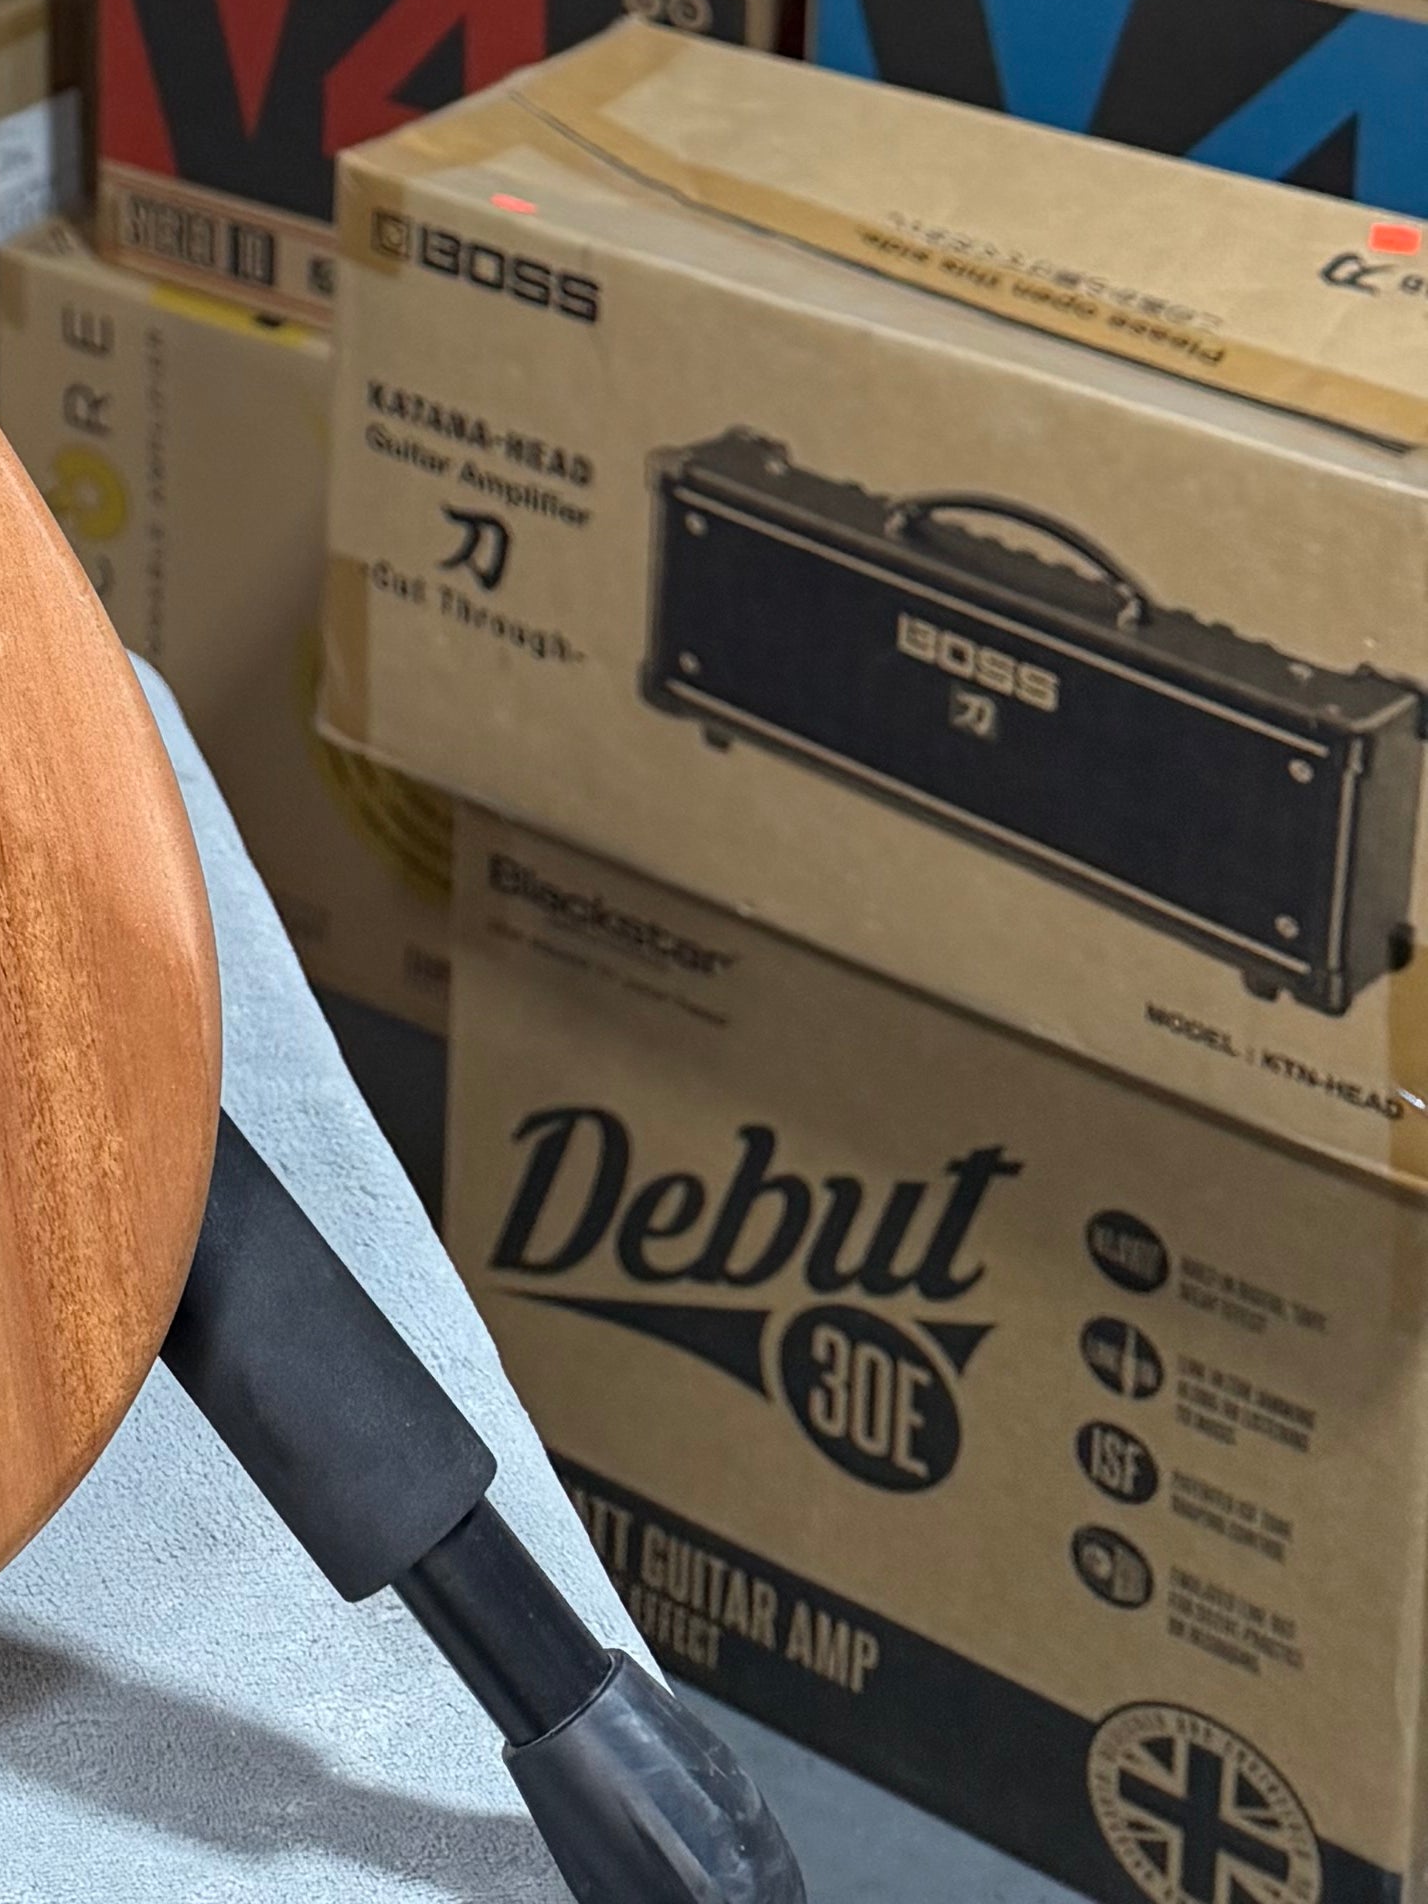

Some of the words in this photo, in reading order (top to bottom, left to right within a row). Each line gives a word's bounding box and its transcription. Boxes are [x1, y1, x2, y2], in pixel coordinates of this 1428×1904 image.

[418, 224, 600, 326] BOSS
[364, 423, 452, 477] Guitar
[457, 461, 592, 529] Amplifier
[365, 378, 596, 489] KATANA-HEAD
[896, 610, 1061, 714] BOSS
[487, 852, 741, 978] Blackstar
[1144, 999, 1241, 1058] MODEL
[486, 1104, 1026, 1306] Debut
[806, 1324, 936, 1484] 30E
[1090, 1426, 1138, 1494] ISF
[640, 1519, 781, 1652] GUITAR
[785, 1597, 881, 1695] AMP
